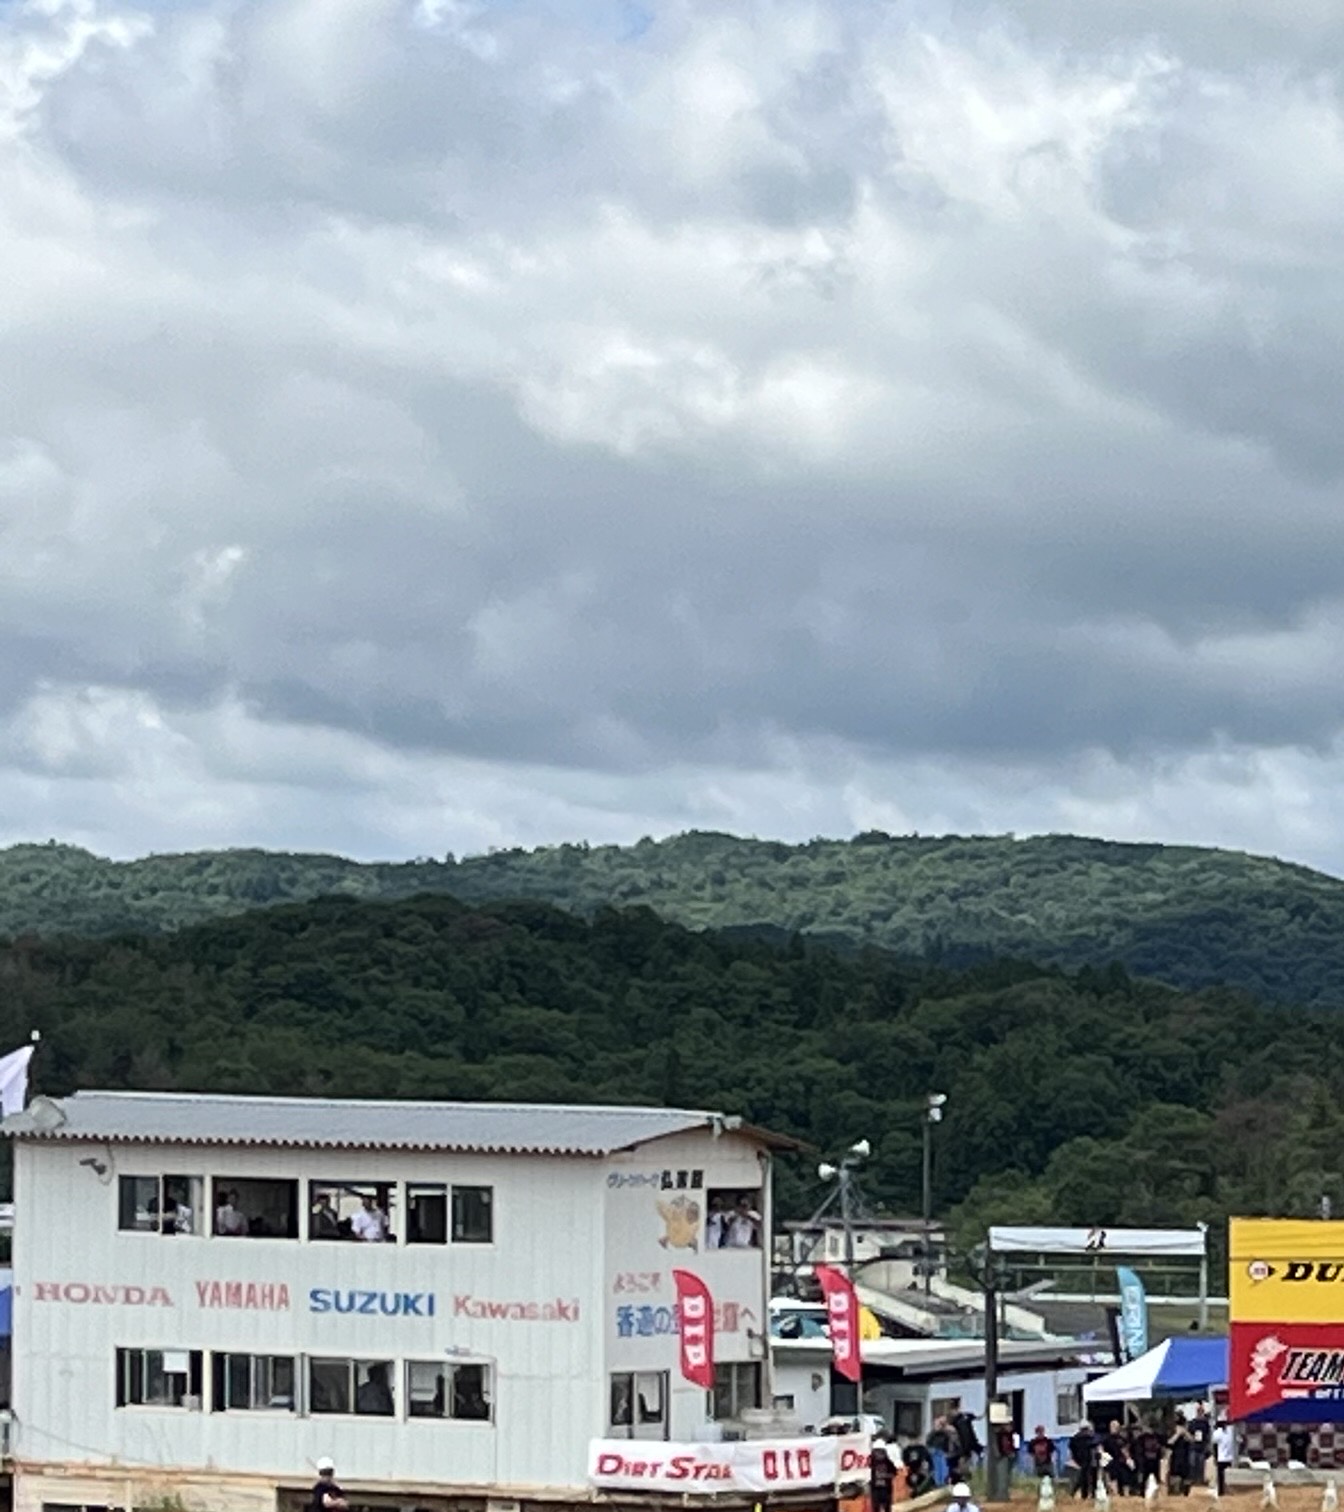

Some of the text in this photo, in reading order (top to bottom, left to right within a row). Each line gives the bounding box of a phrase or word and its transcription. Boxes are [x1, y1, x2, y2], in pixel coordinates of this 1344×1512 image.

[34, 1280, 580, 1322] HONDA YAMAHA SUZUKI Kawasaki
